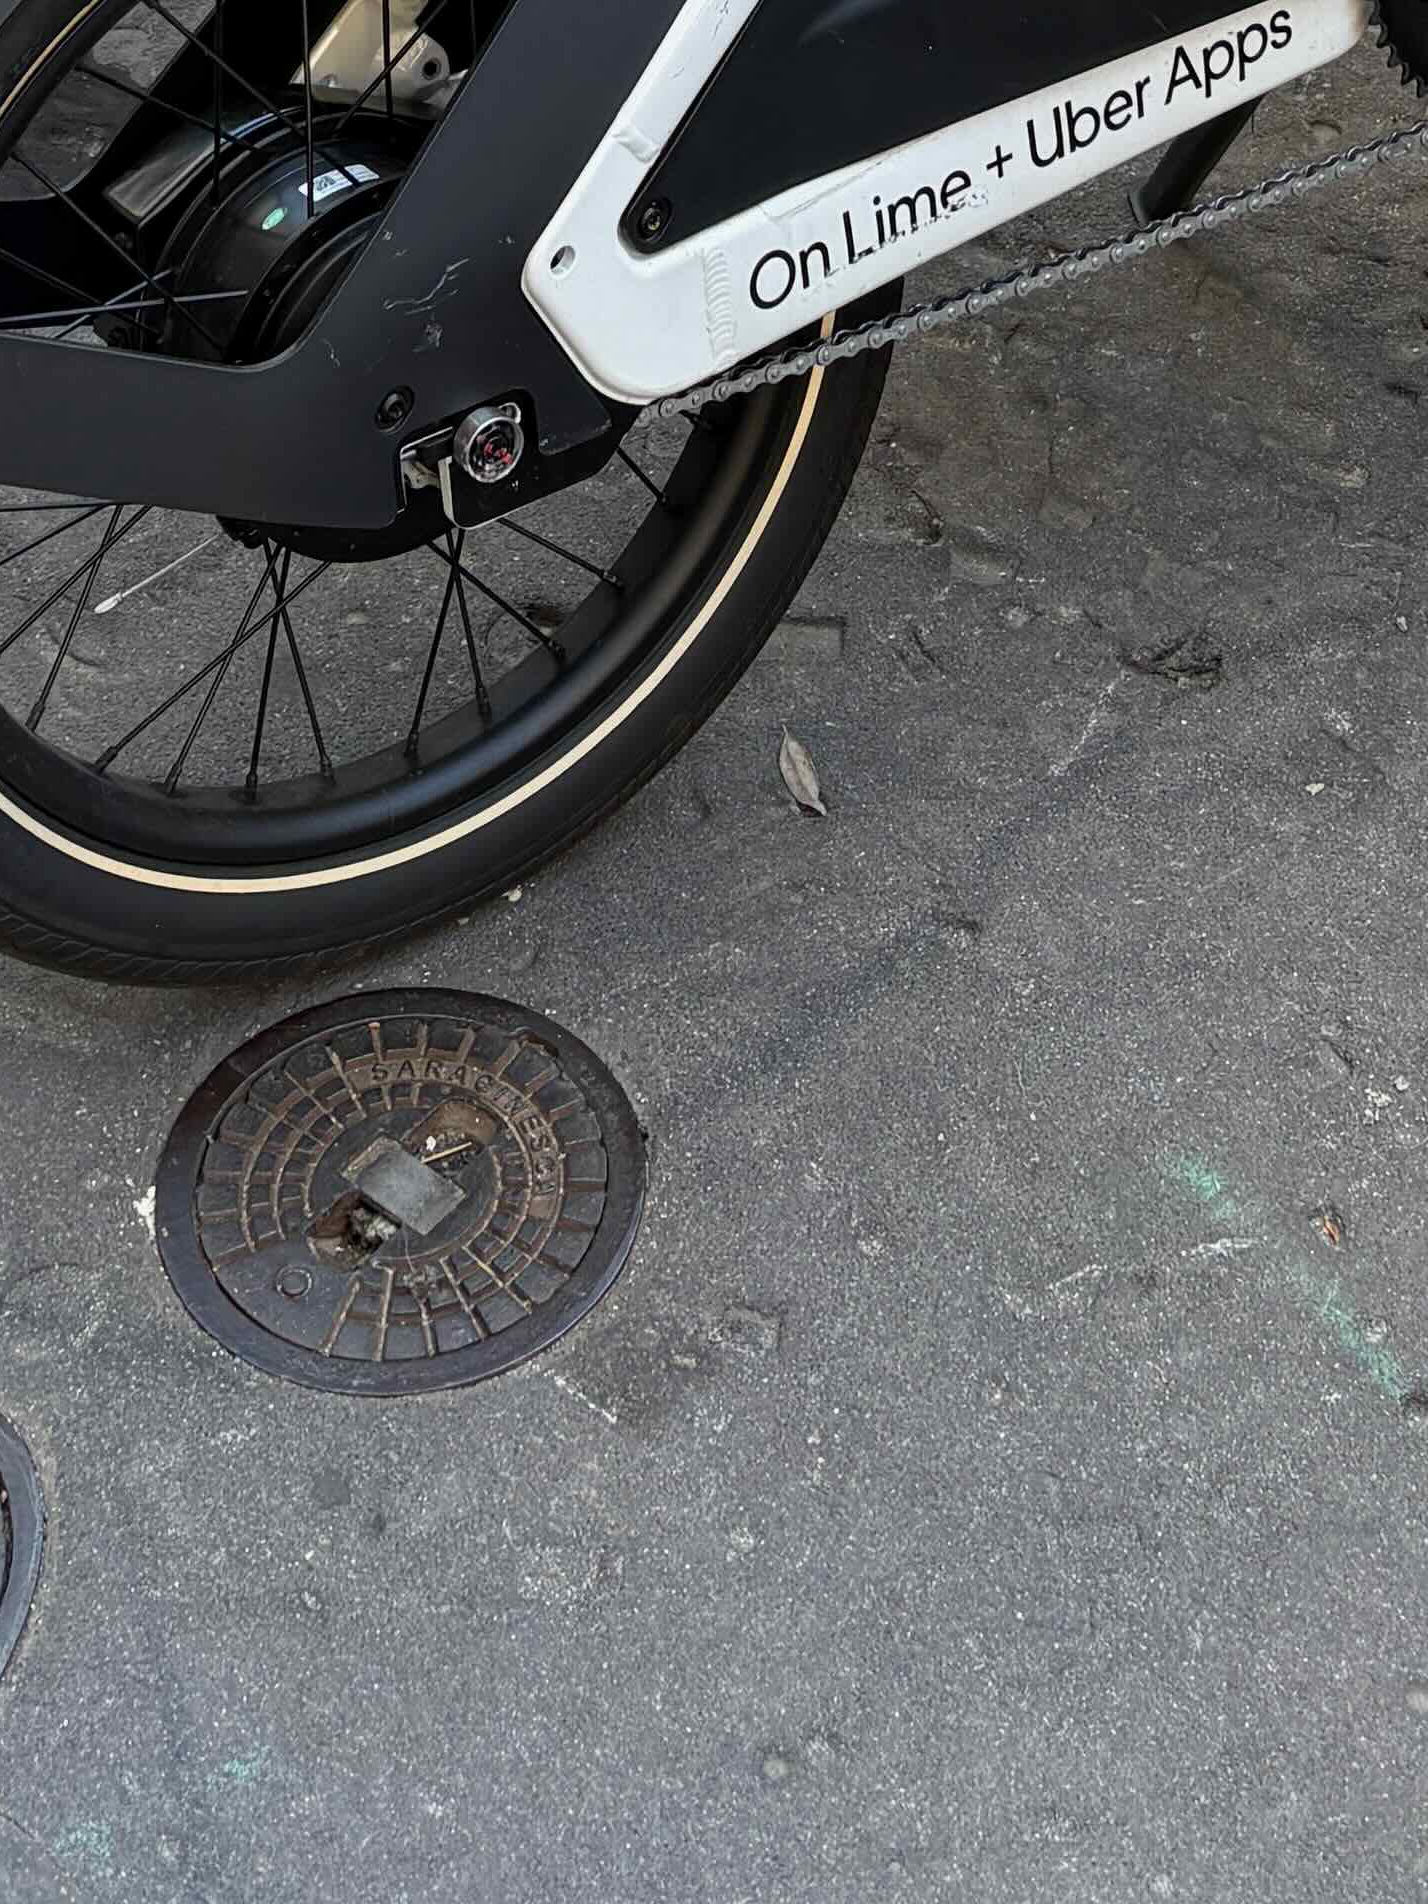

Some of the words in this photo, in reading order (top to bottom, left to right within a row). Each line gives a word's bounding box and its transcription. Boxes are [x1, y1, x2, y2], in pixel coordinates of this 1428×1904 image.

[749, 239, 831, 310] On
[843, 168, 972, 262] Lime
[985, 144, 1014, 180] +
[1027, 75, 1152, 170] Uber
[1165, 8, 1293, 106] Apps
